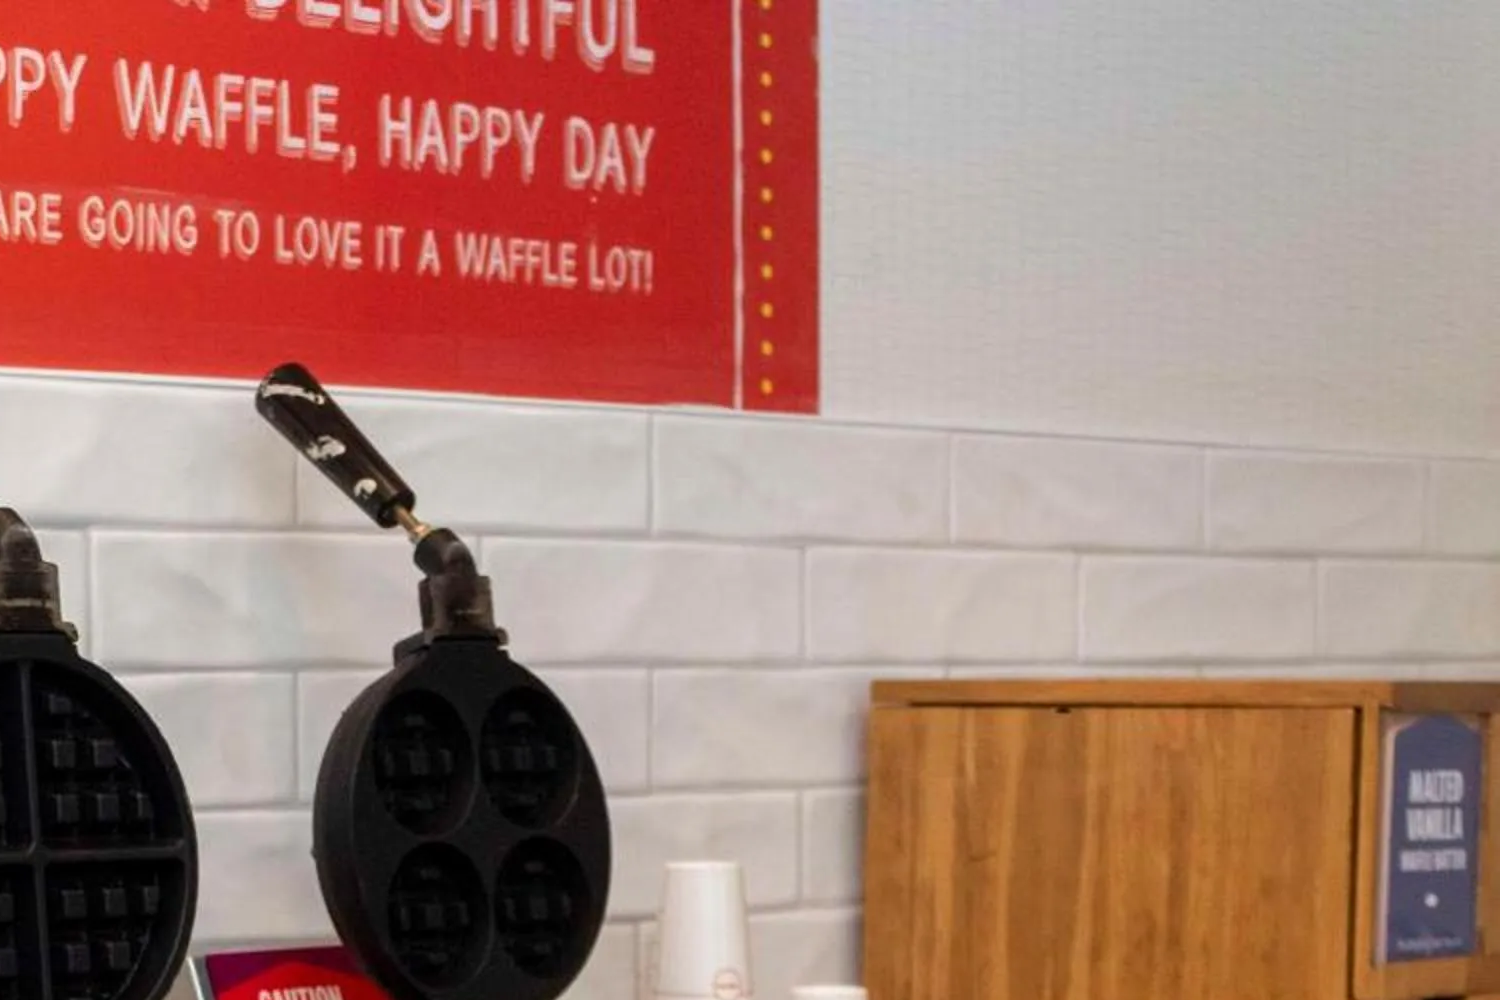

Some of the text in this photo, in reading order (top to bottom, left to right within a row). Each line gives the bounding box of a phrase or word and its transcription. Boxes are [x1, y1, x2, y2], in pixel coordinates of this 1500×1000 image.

[246, 0, 655, 74] GHTFUL
[114, 57, 358, 174] WAFFLE,
[378, 93, 544, 185] HAPPY
[564, 116, 655, 196] DAY
[78, 194, 198, 256] GOING
[213, 208, 261, 261] TO
[274, 212, 363, 270] LOVE
[375, 224, 405, 273] IT
[416, 228, 442, 278] A
[454, 230, 578, 289] WAFFLE
[587, 238, 655, 297] LOT!
